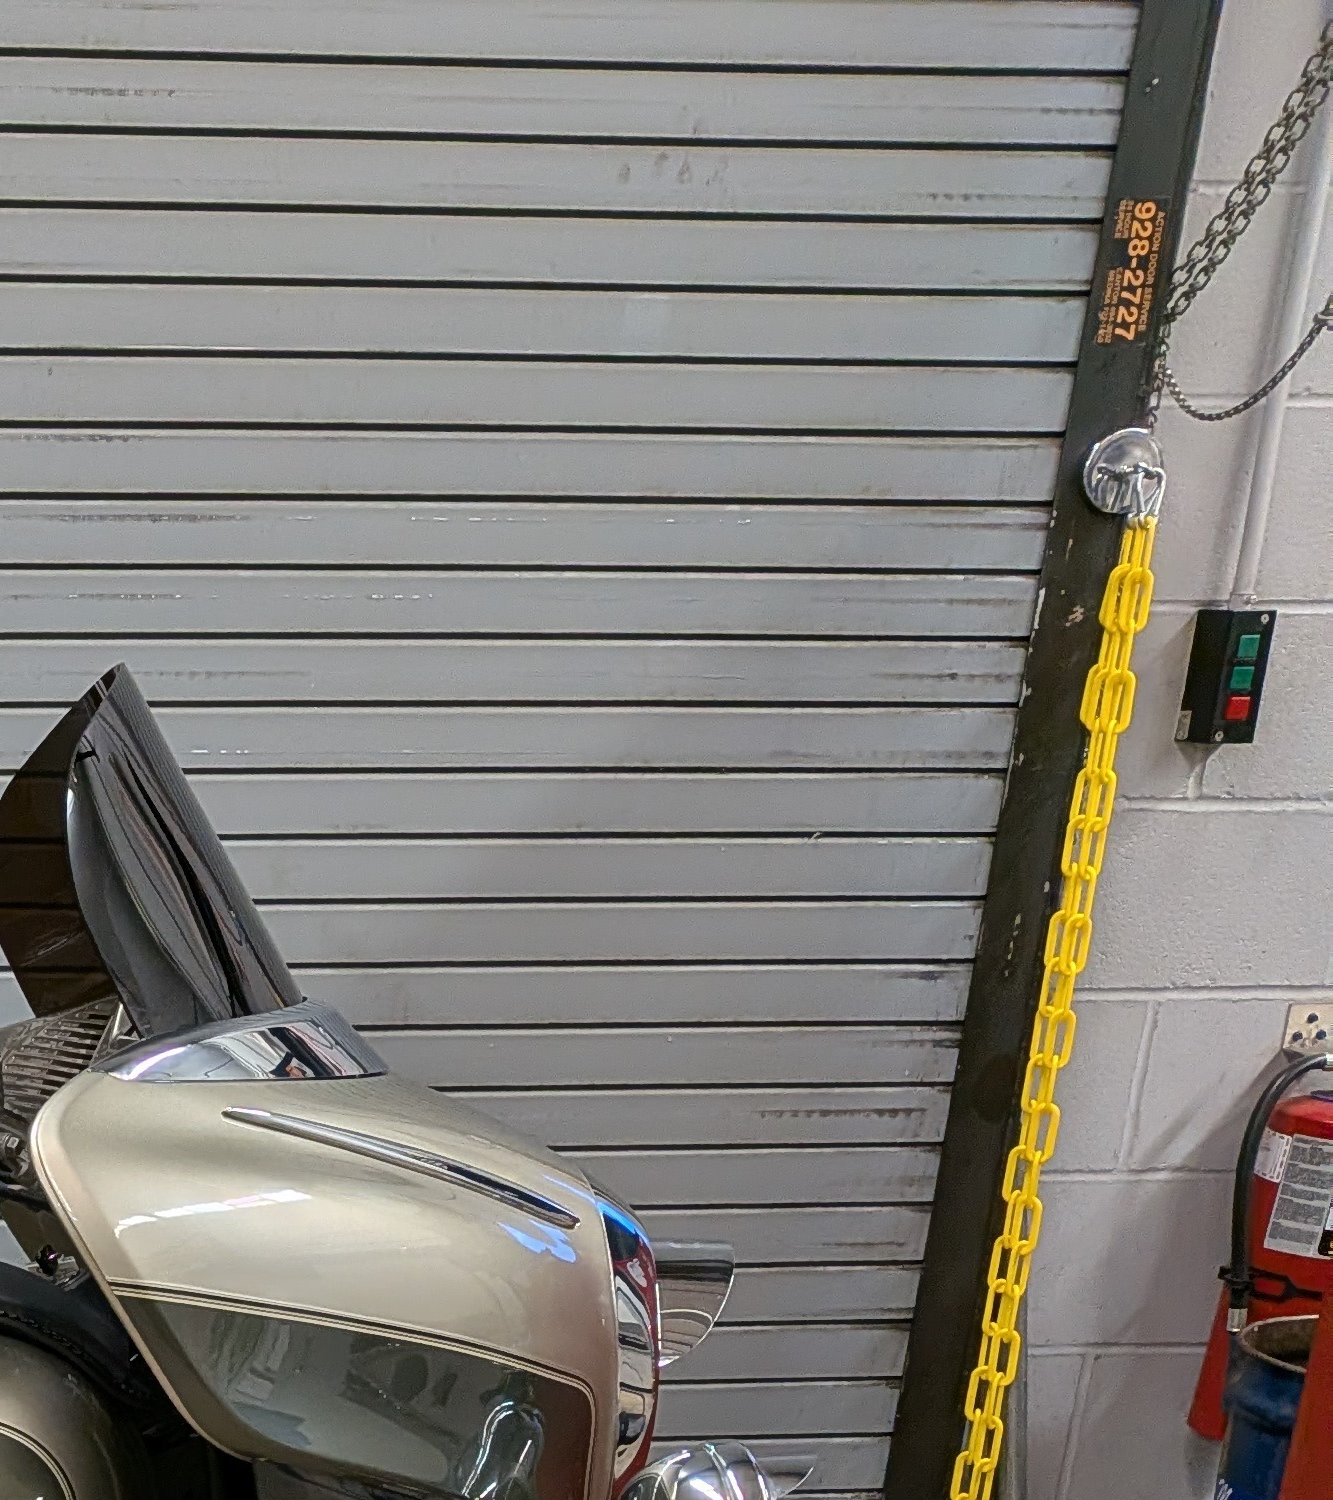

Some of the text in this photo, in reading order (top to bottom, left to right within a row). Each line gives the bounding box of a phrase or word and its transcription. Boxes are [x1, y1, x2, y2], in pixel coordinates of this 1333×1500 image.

[1152, 211, 1166, 251] ACTION
[1114, 201, 1157, 341] 928-2727
[1146, 254, 1158, 285] DOOR
